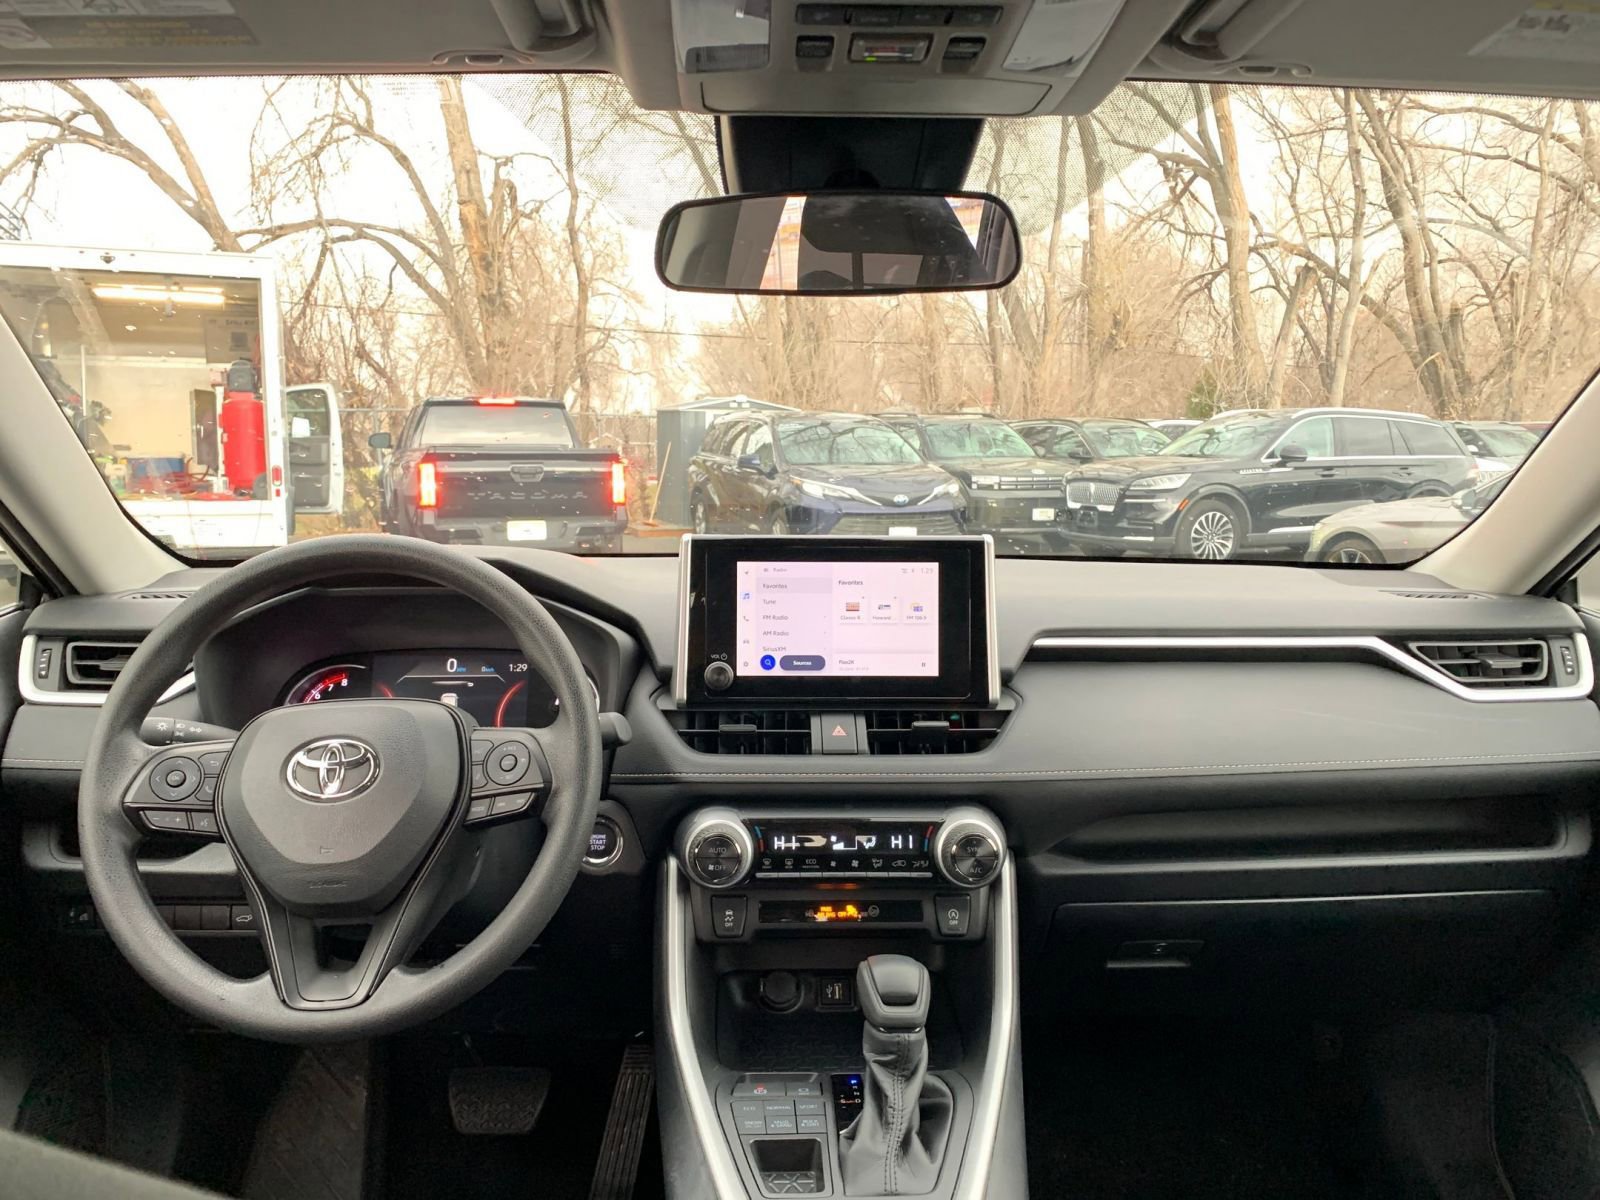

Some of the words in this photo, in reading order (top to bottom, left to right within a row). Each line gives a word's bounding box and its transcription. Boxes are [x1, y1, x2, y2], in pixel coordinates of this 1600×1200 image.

[446, 658, 458, 673] 0
[508, 663, 528, 672] 1:29
[341, 678, 348, 687] 8
[327, 683, 334, 692] 7
[314, 691, 321, 700] 6
[891, 834, 913, 849] HI
